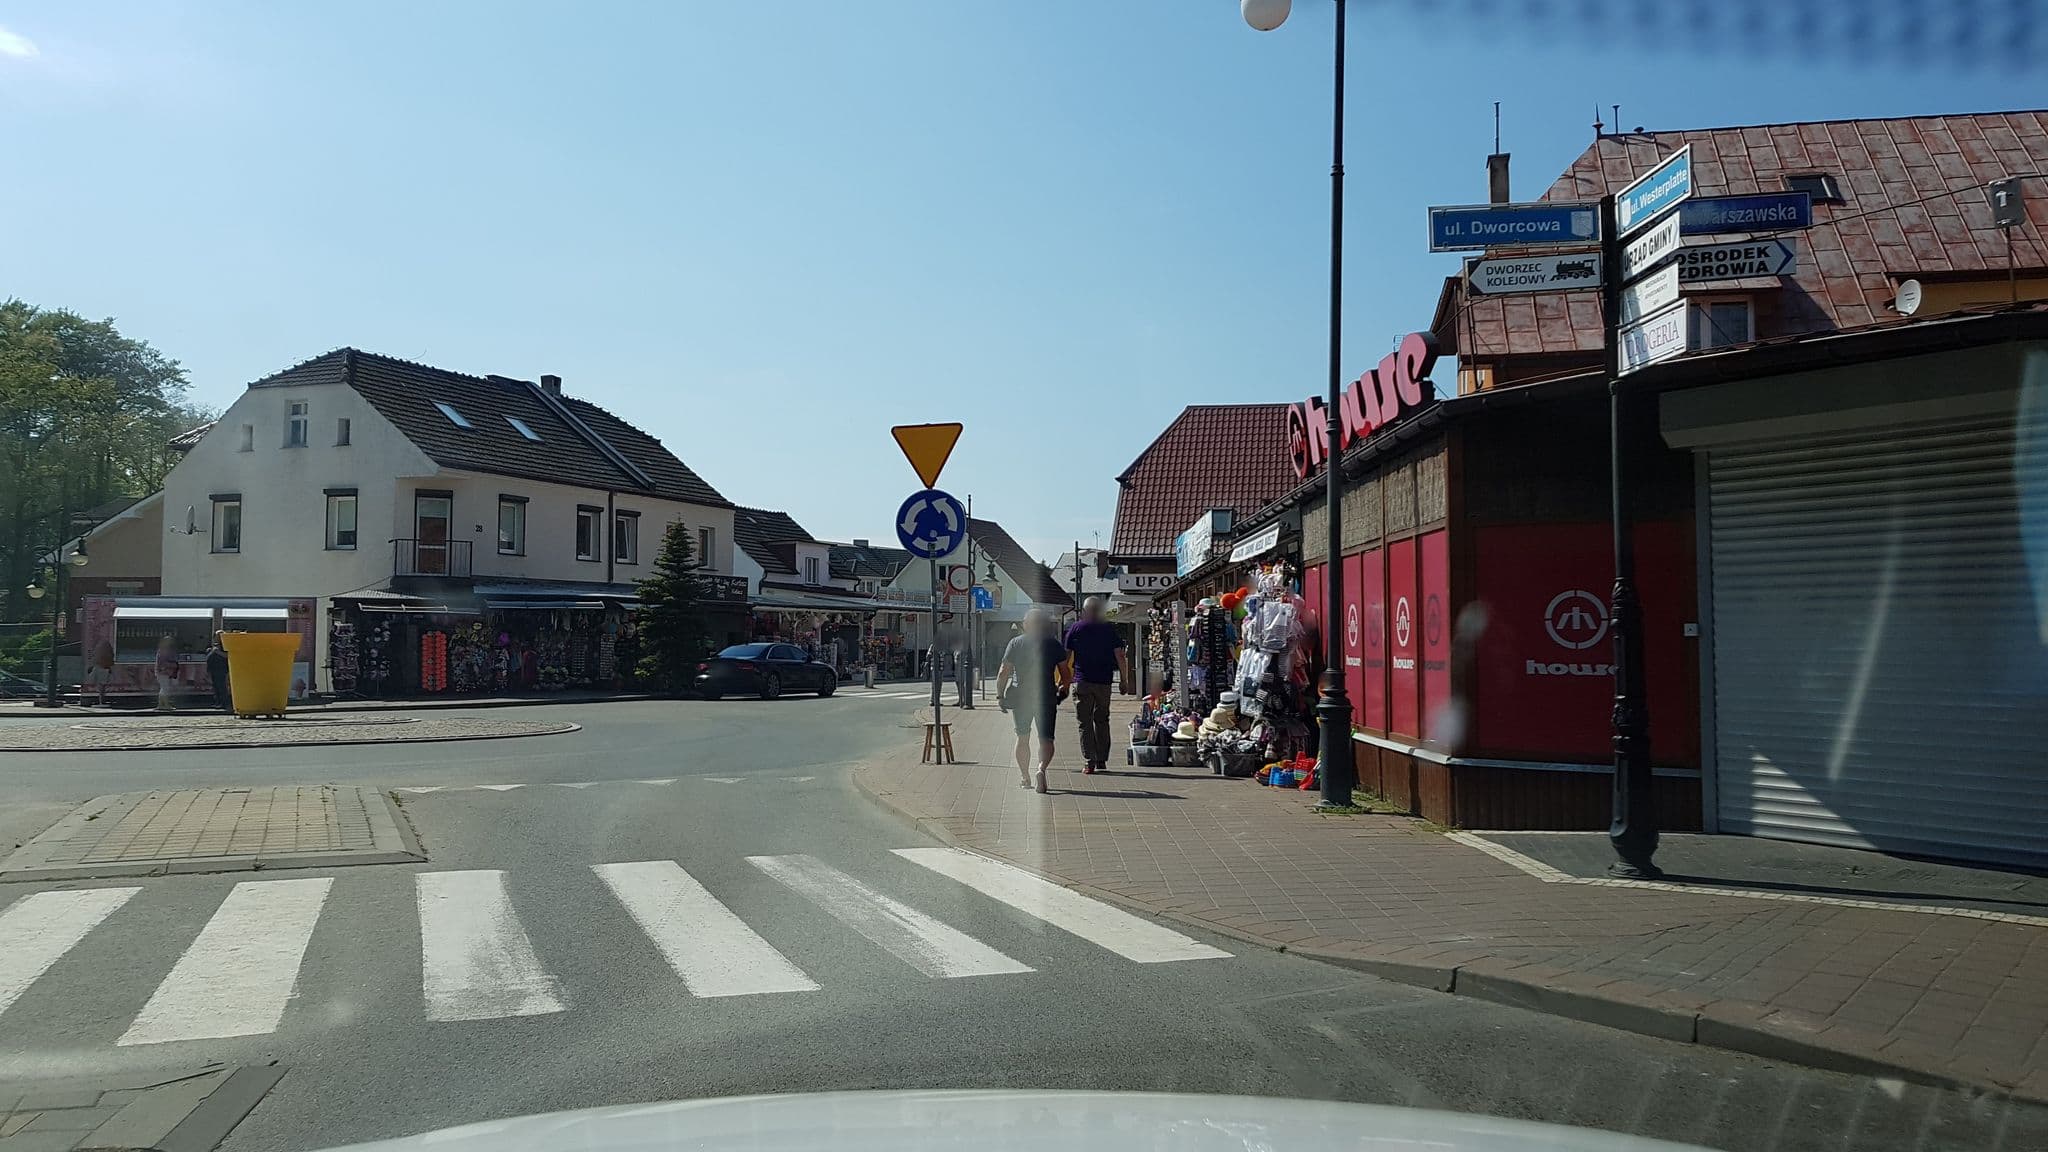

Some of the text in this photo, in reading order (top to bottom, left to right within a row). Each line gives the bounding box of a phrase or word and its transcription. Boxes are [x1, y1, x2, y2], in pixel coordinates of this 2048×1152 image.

[1640, 168, 1687, 209] Westerplatte
[1445, 220, 1561, 236] ul. Dworcowa
[1624, 223, 1673, 273] URZĄD GMINY
[1673, 245, 1771, 265] OŚRODEK
[1486, 262, 1542, 275] DWORZEC
[1678, 260, 1769, 279] ZDROWIA
[1487, 274, 1546, 287] KOLEJOWY
[1627, 320, 1680, 359] DROGERIA
